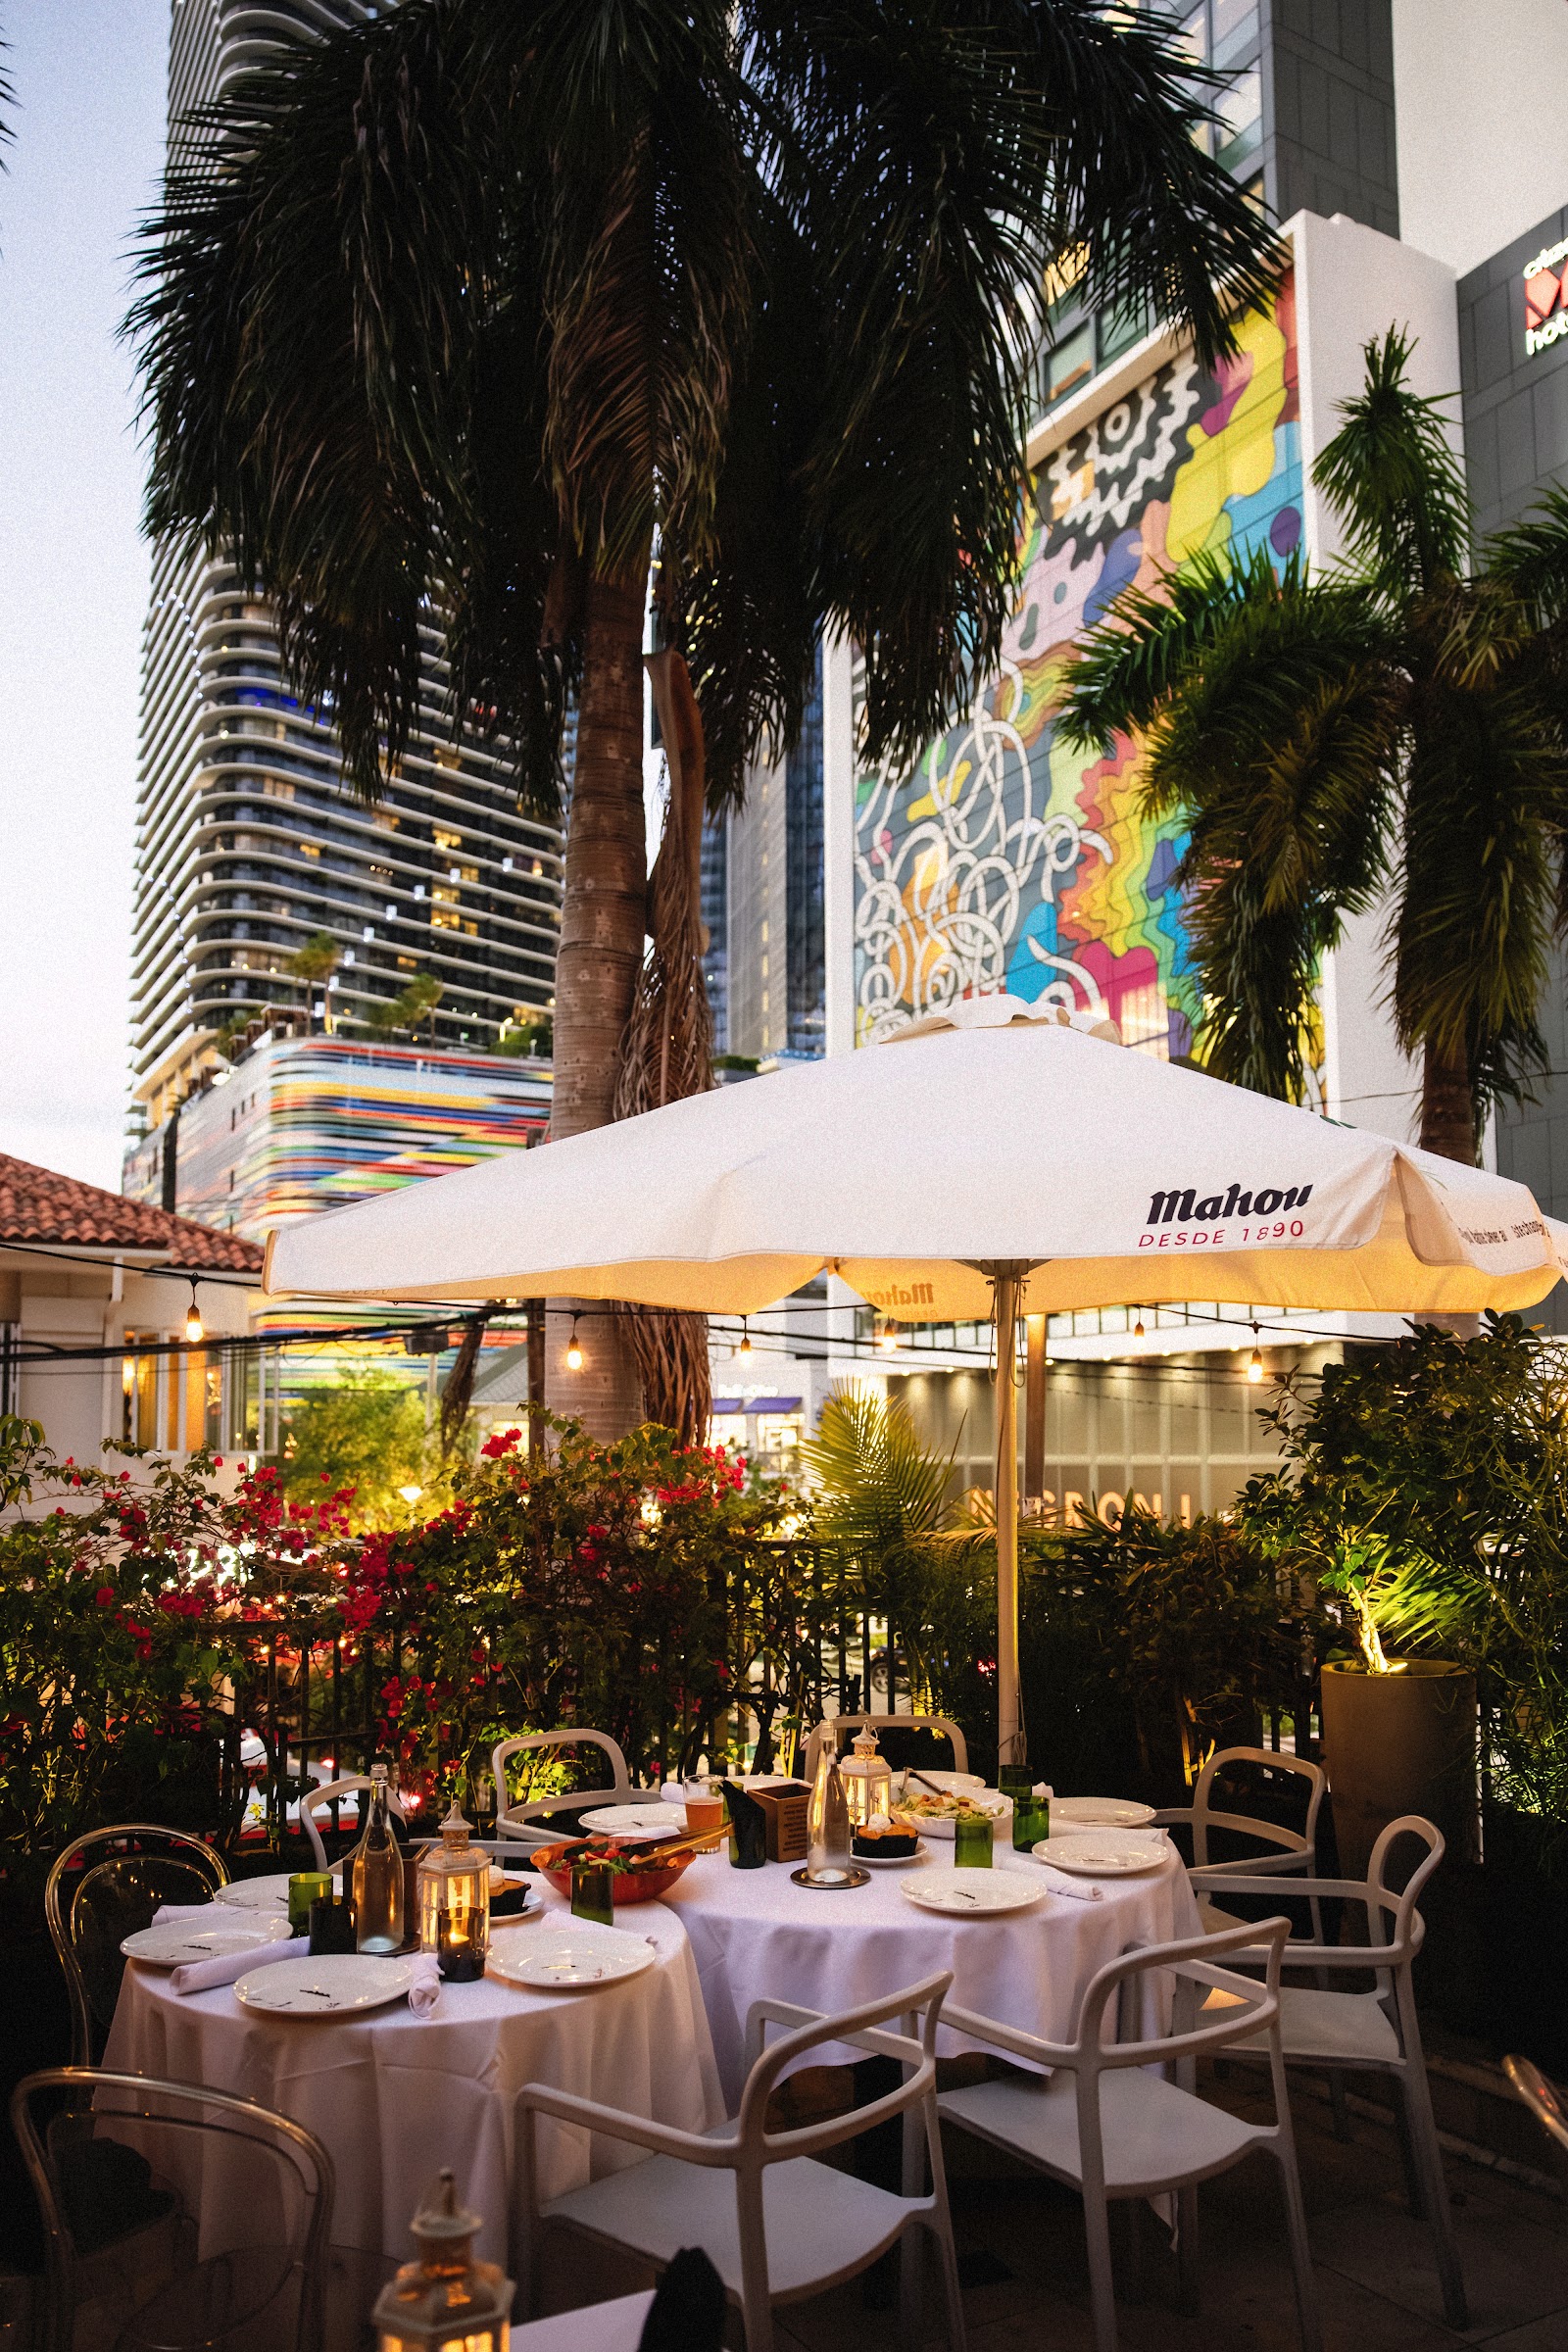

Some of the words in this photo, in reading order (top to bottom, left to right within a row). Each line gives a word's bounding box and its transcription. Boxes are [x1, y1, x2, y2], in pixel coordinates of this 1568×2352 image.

[1146, 1183, 1314, 1225] Mahou
[1138, 1229, 1226, 1248] DESDE
[1242, 1220, 1304, 1242] 1890
[970, 1489, 1192, 1532] NGRONI
